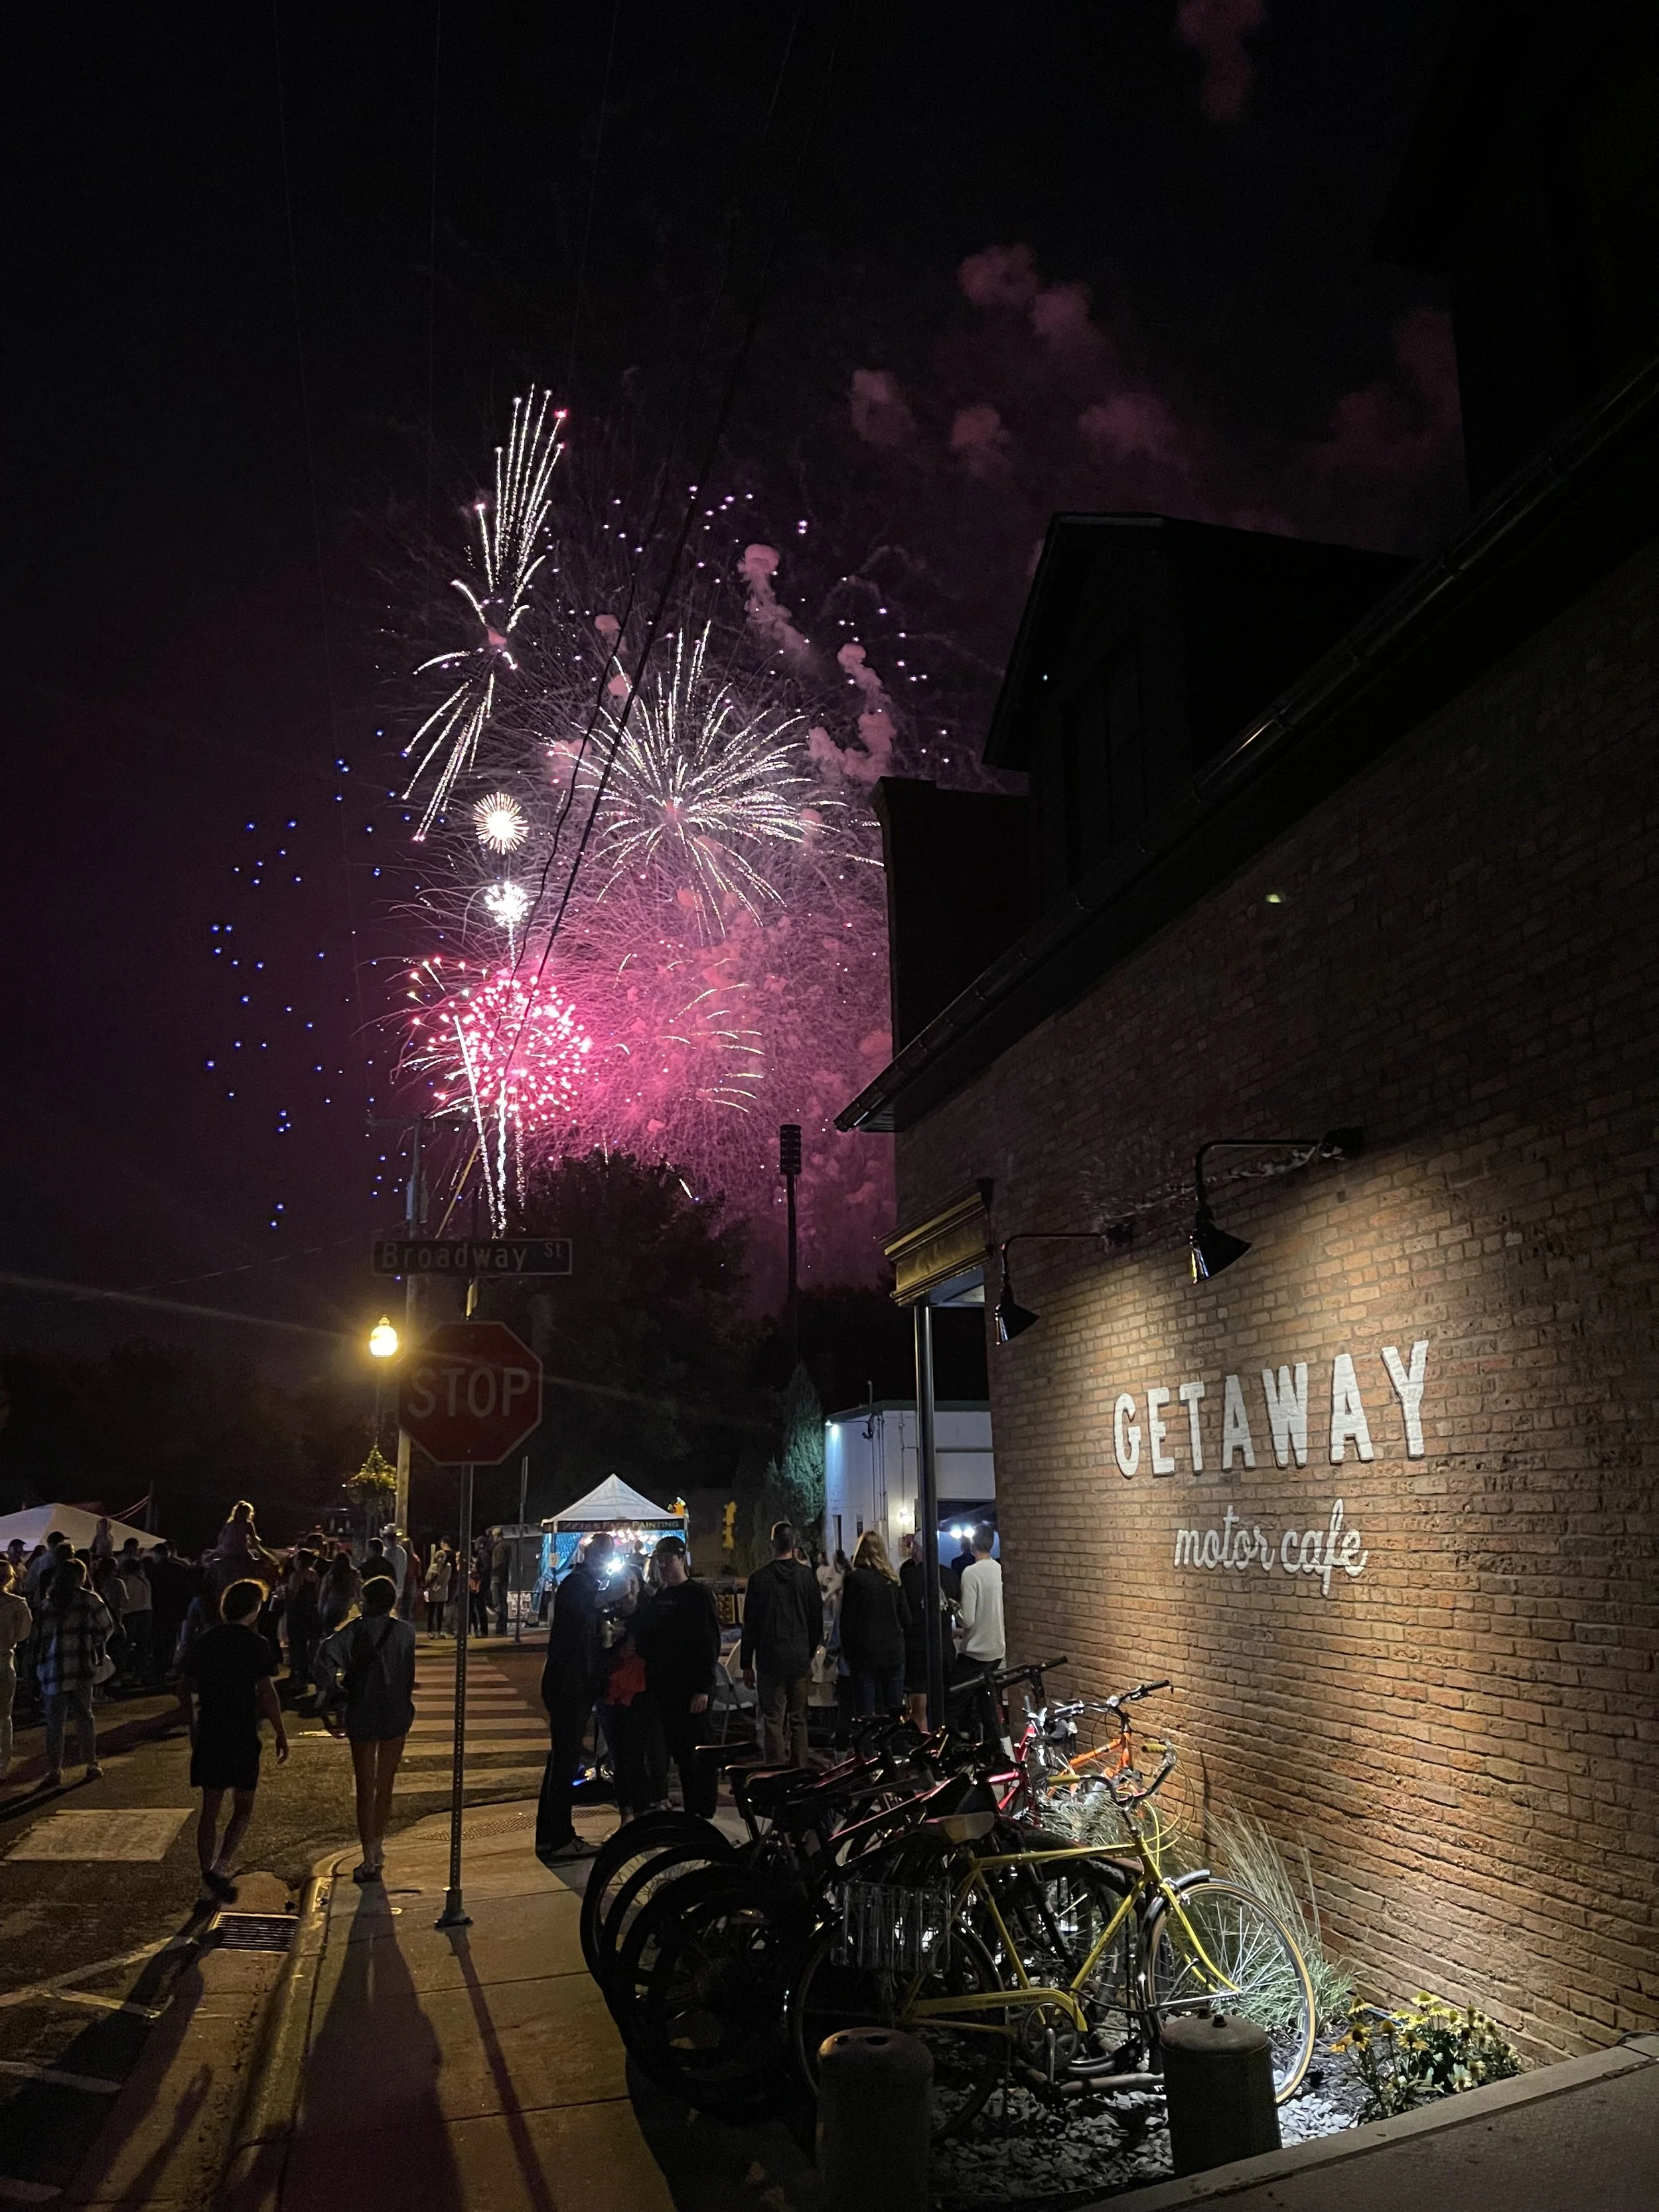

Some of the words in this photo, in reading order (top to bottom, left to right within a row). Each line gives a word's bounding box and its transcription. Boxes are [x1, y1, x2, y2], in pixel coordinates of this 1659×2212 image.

[382, 1243, 528, 1272] Broadway
[543, 1242, 562, 1258] St
[407, 1367, 530, 1418] STOP
[1113, 1340, 1429, 1478] GETAWAY
[1174, 1505, 1275, 1571] motor
[1281, 1499, 1369, 1595] cafe
